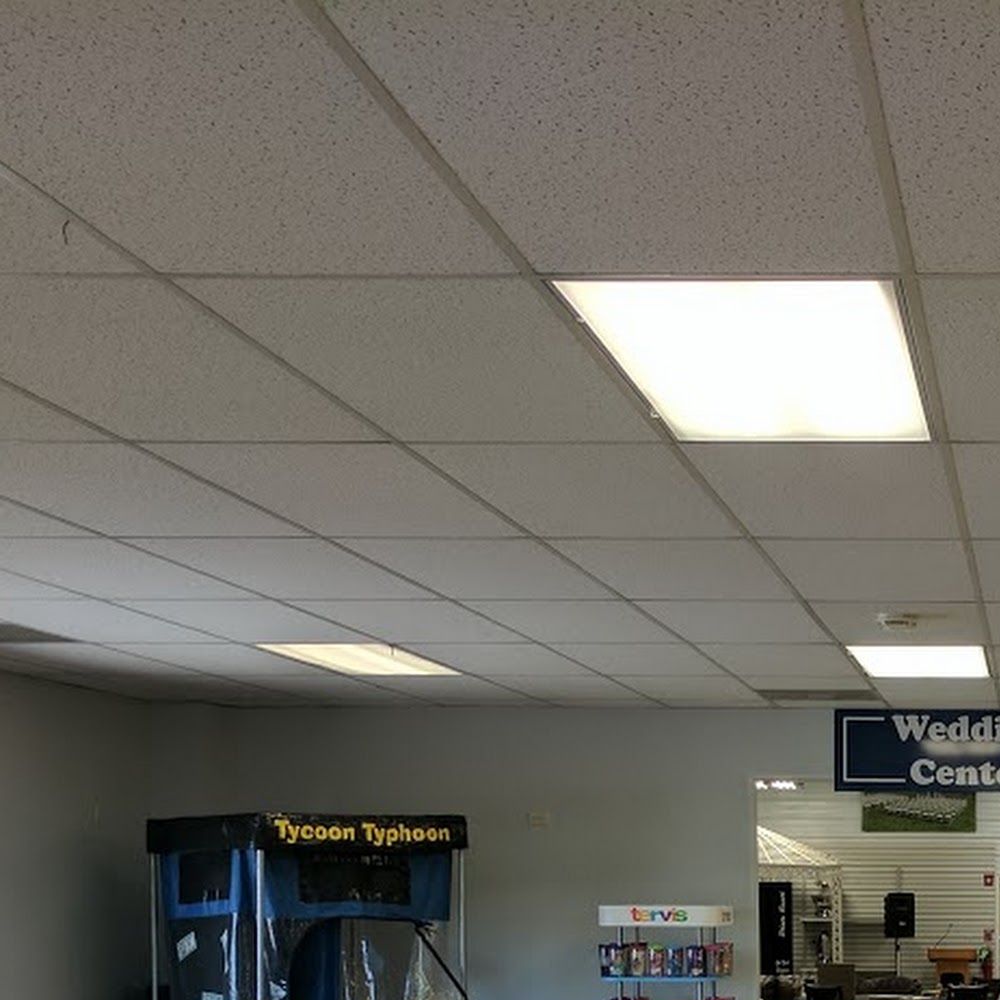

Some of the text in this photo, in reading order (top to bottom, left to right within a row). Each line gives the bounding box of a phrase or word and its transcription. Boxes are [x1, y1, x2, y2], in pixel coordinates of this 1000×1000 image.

[274, 819, 450, 846] Tycoon Typhoon
[629, 907, 689, 922] tervis
